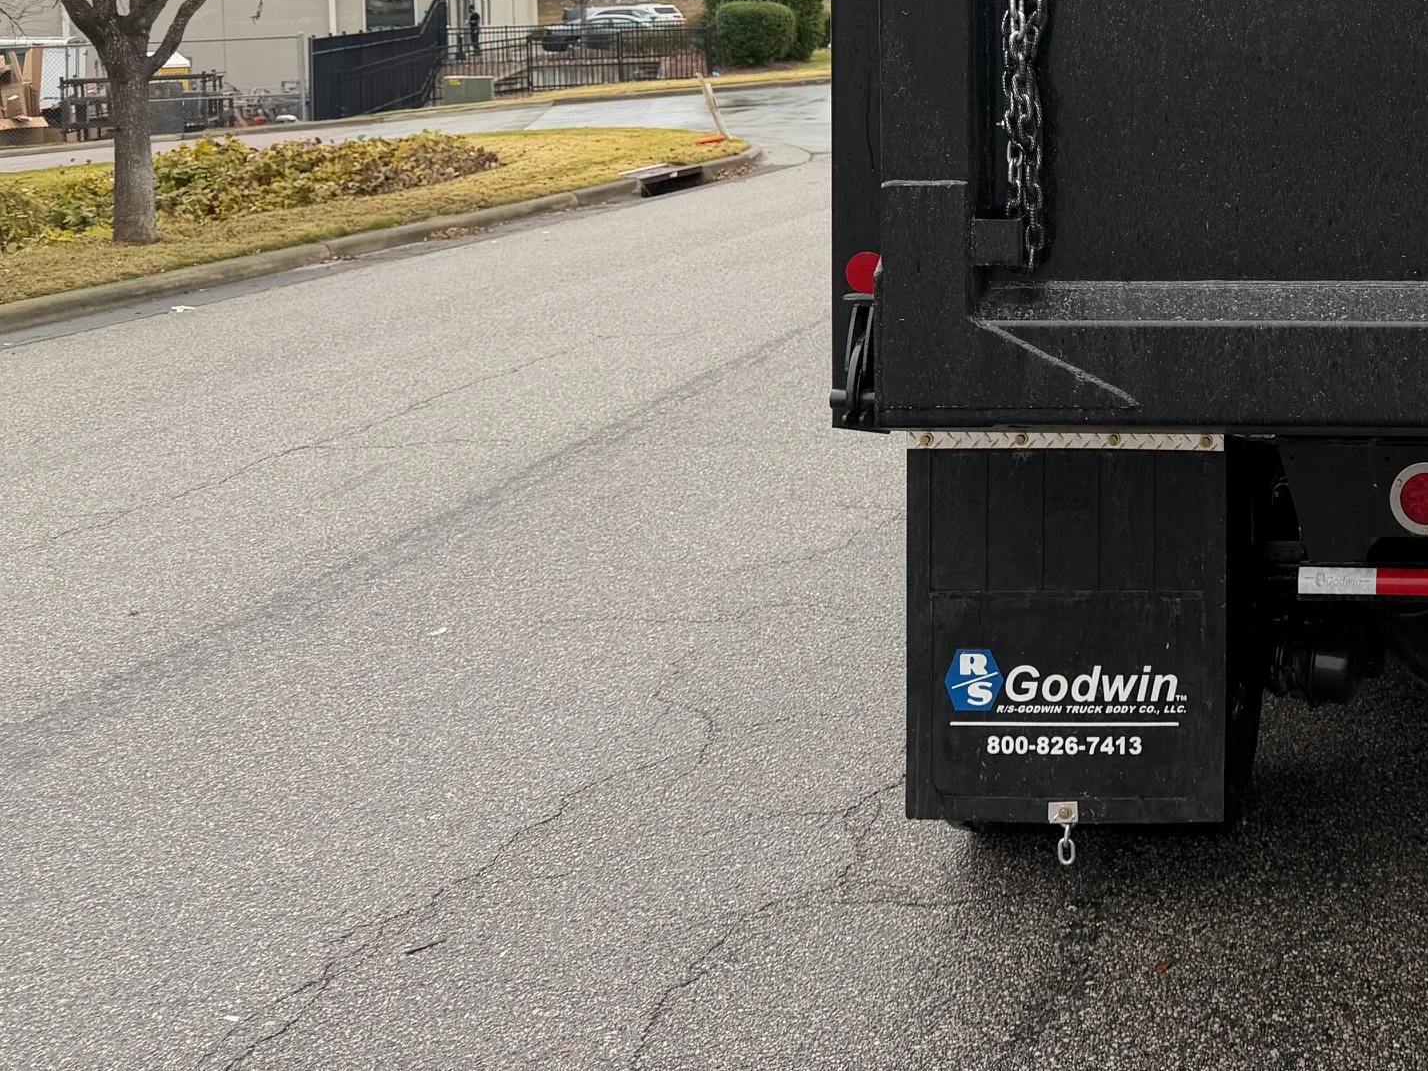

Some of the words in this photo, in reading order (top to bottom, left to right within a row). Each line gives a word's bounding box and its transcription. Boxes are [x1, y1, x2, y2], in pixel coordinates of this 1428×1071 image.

[1005, 665, 1179, 702] Godwin
[1066, 705, 1103, 714] TRUCK
[1105, 705, 1137, 714] BODY
[1163, 705, 1187, 714] LLC.
[986, 735, 1143, 755] 800-826-7413
